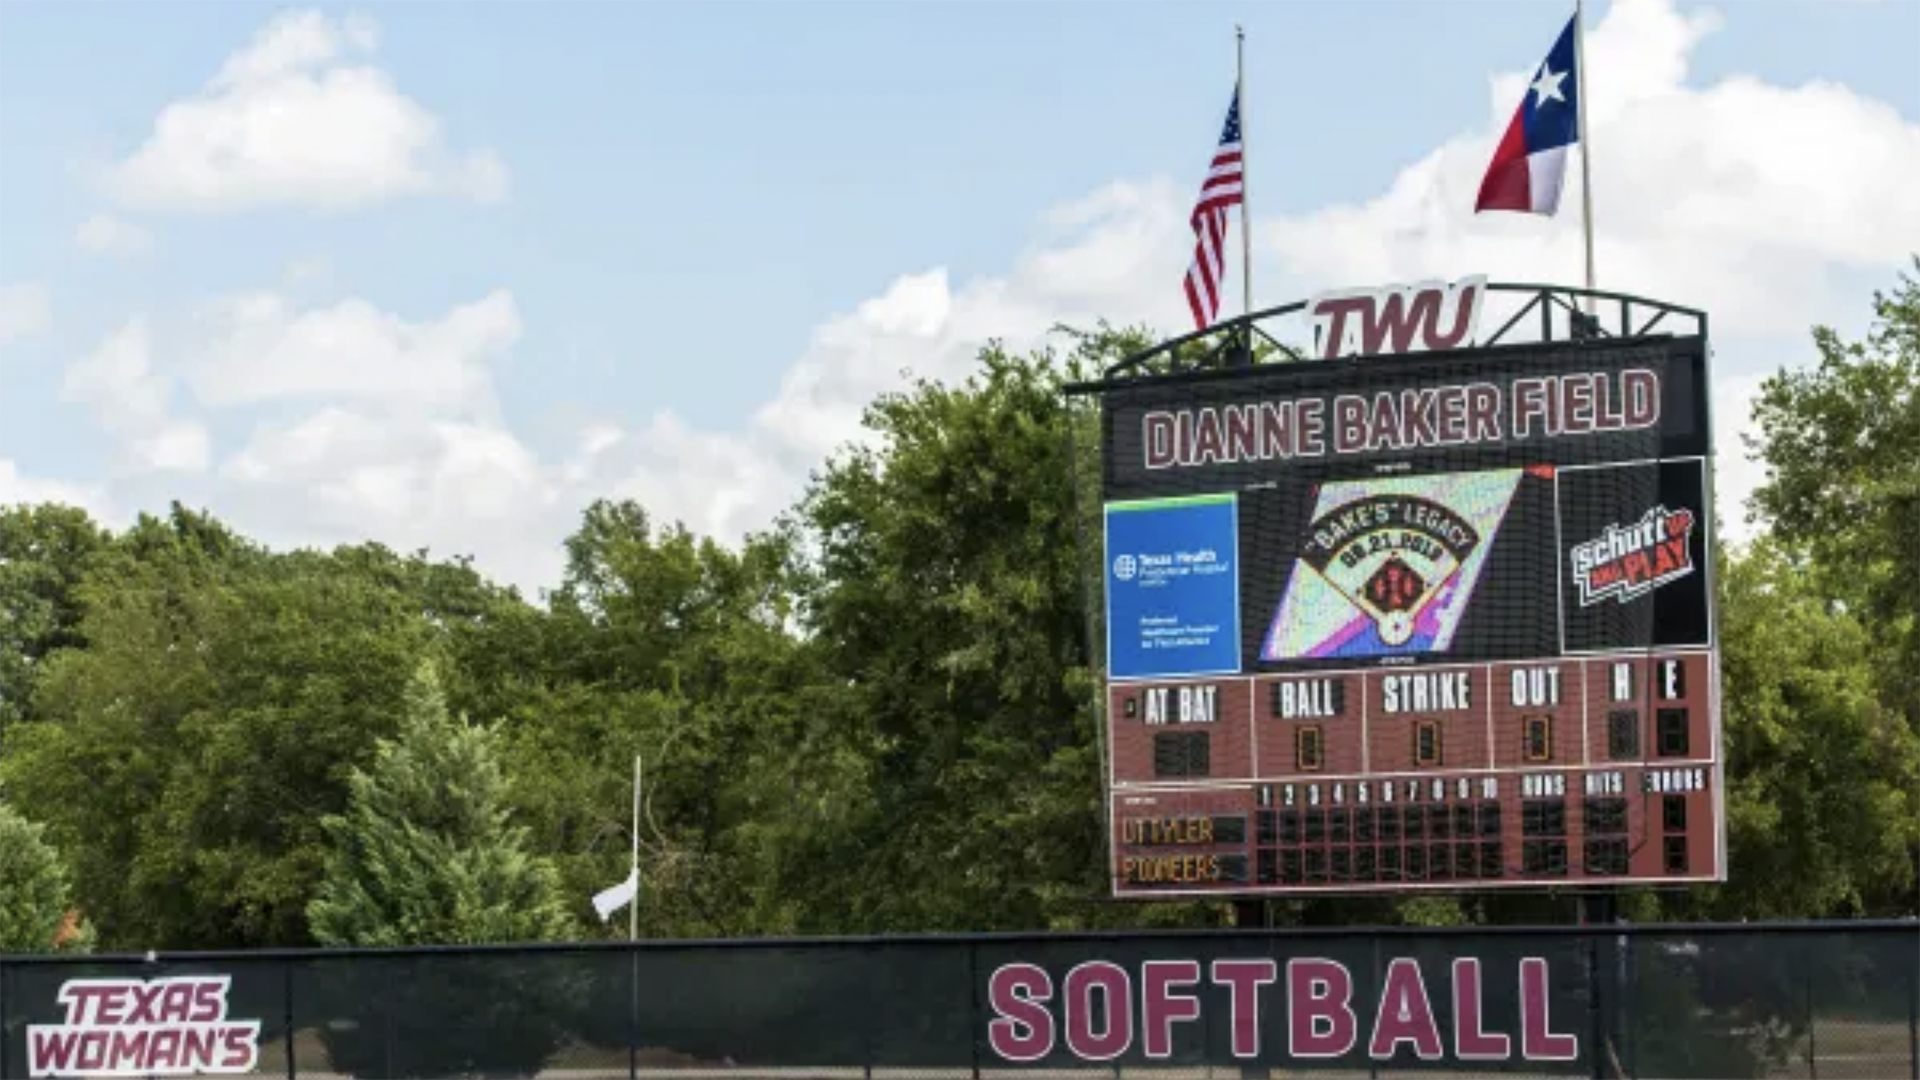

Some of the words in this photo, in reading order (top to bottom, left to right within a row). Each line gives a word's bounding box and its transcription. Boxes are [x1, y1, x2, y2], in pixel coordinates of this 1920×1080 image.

[1312, 280, 1480, 359] TWU
[1143, 398, 1325, 470] DIANNE
[1333, 383, 1500, 454] BAKER
[1512, 369, 1661, 439] FIELD
[1404, 503, 1470, 548] LEGACY
[1623, 537, 1685, 584] PLAY
[1280, 679, 1335, 719] BALL
[1384, 672, 1469, 713] STRIKE
[1512, 666, 1559, 706] OUT
[1665, 660, 1677, 699] E
[1145, 687, 1169, 724] AT
[1179, 685, 1217, 723] BAT
[1262, 786, 1269, 805] 1
[1285, 785, 1294, 805] 2
[1311, 784, 1320, 805] 3
[1334, 783, 1344, 804] 4
[1359, 782, 1368, 802] 5
[1410, 781, 1419, 801] 7
[1482, 778, 1499, 798] 10
[1123, 854, 1219, 882] PIONEERS
[62, 979, 225, 1025] TEXAS
[988, 957, 1579, 1061] SOFTBALL
[31, 1025, 256, 1072] WOMAN'S
